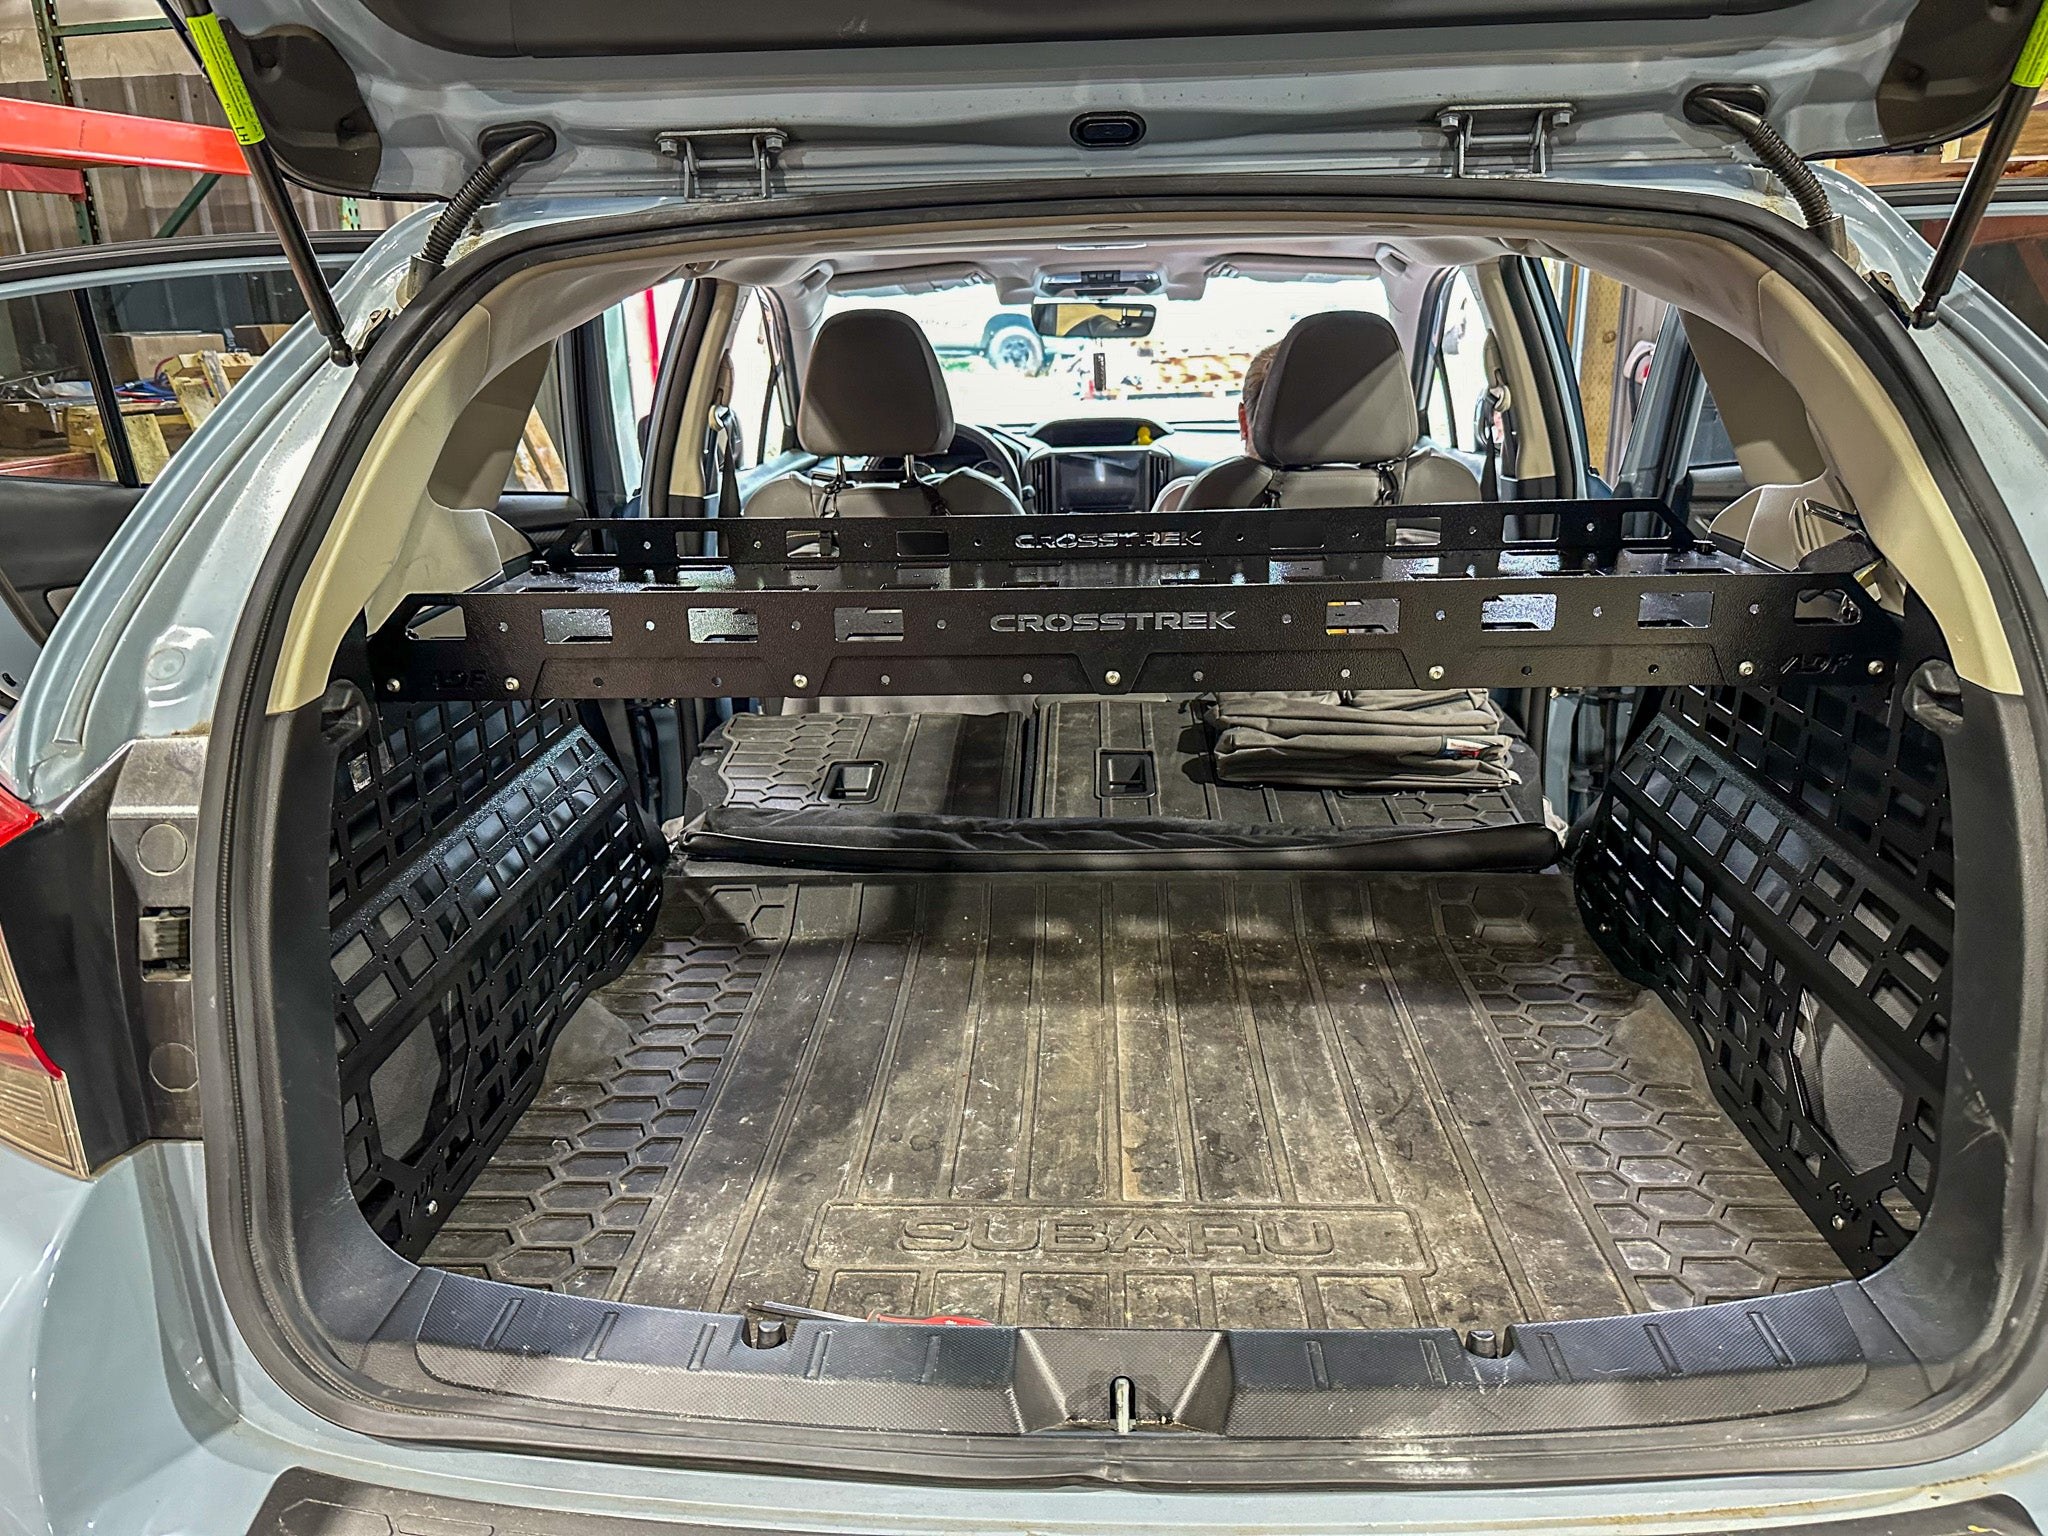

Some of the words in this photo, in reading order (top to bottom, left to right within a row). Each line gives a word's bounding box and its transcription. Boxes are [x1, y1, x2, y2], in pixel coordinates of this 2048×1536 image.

[235, 126, 250, 143] LH
[1014, 530, 1202, 549] CROSSTREK
[989, 610, 1236, 632] CROSSTREK
[901, 1218, 1335, 1256] SUBARU
